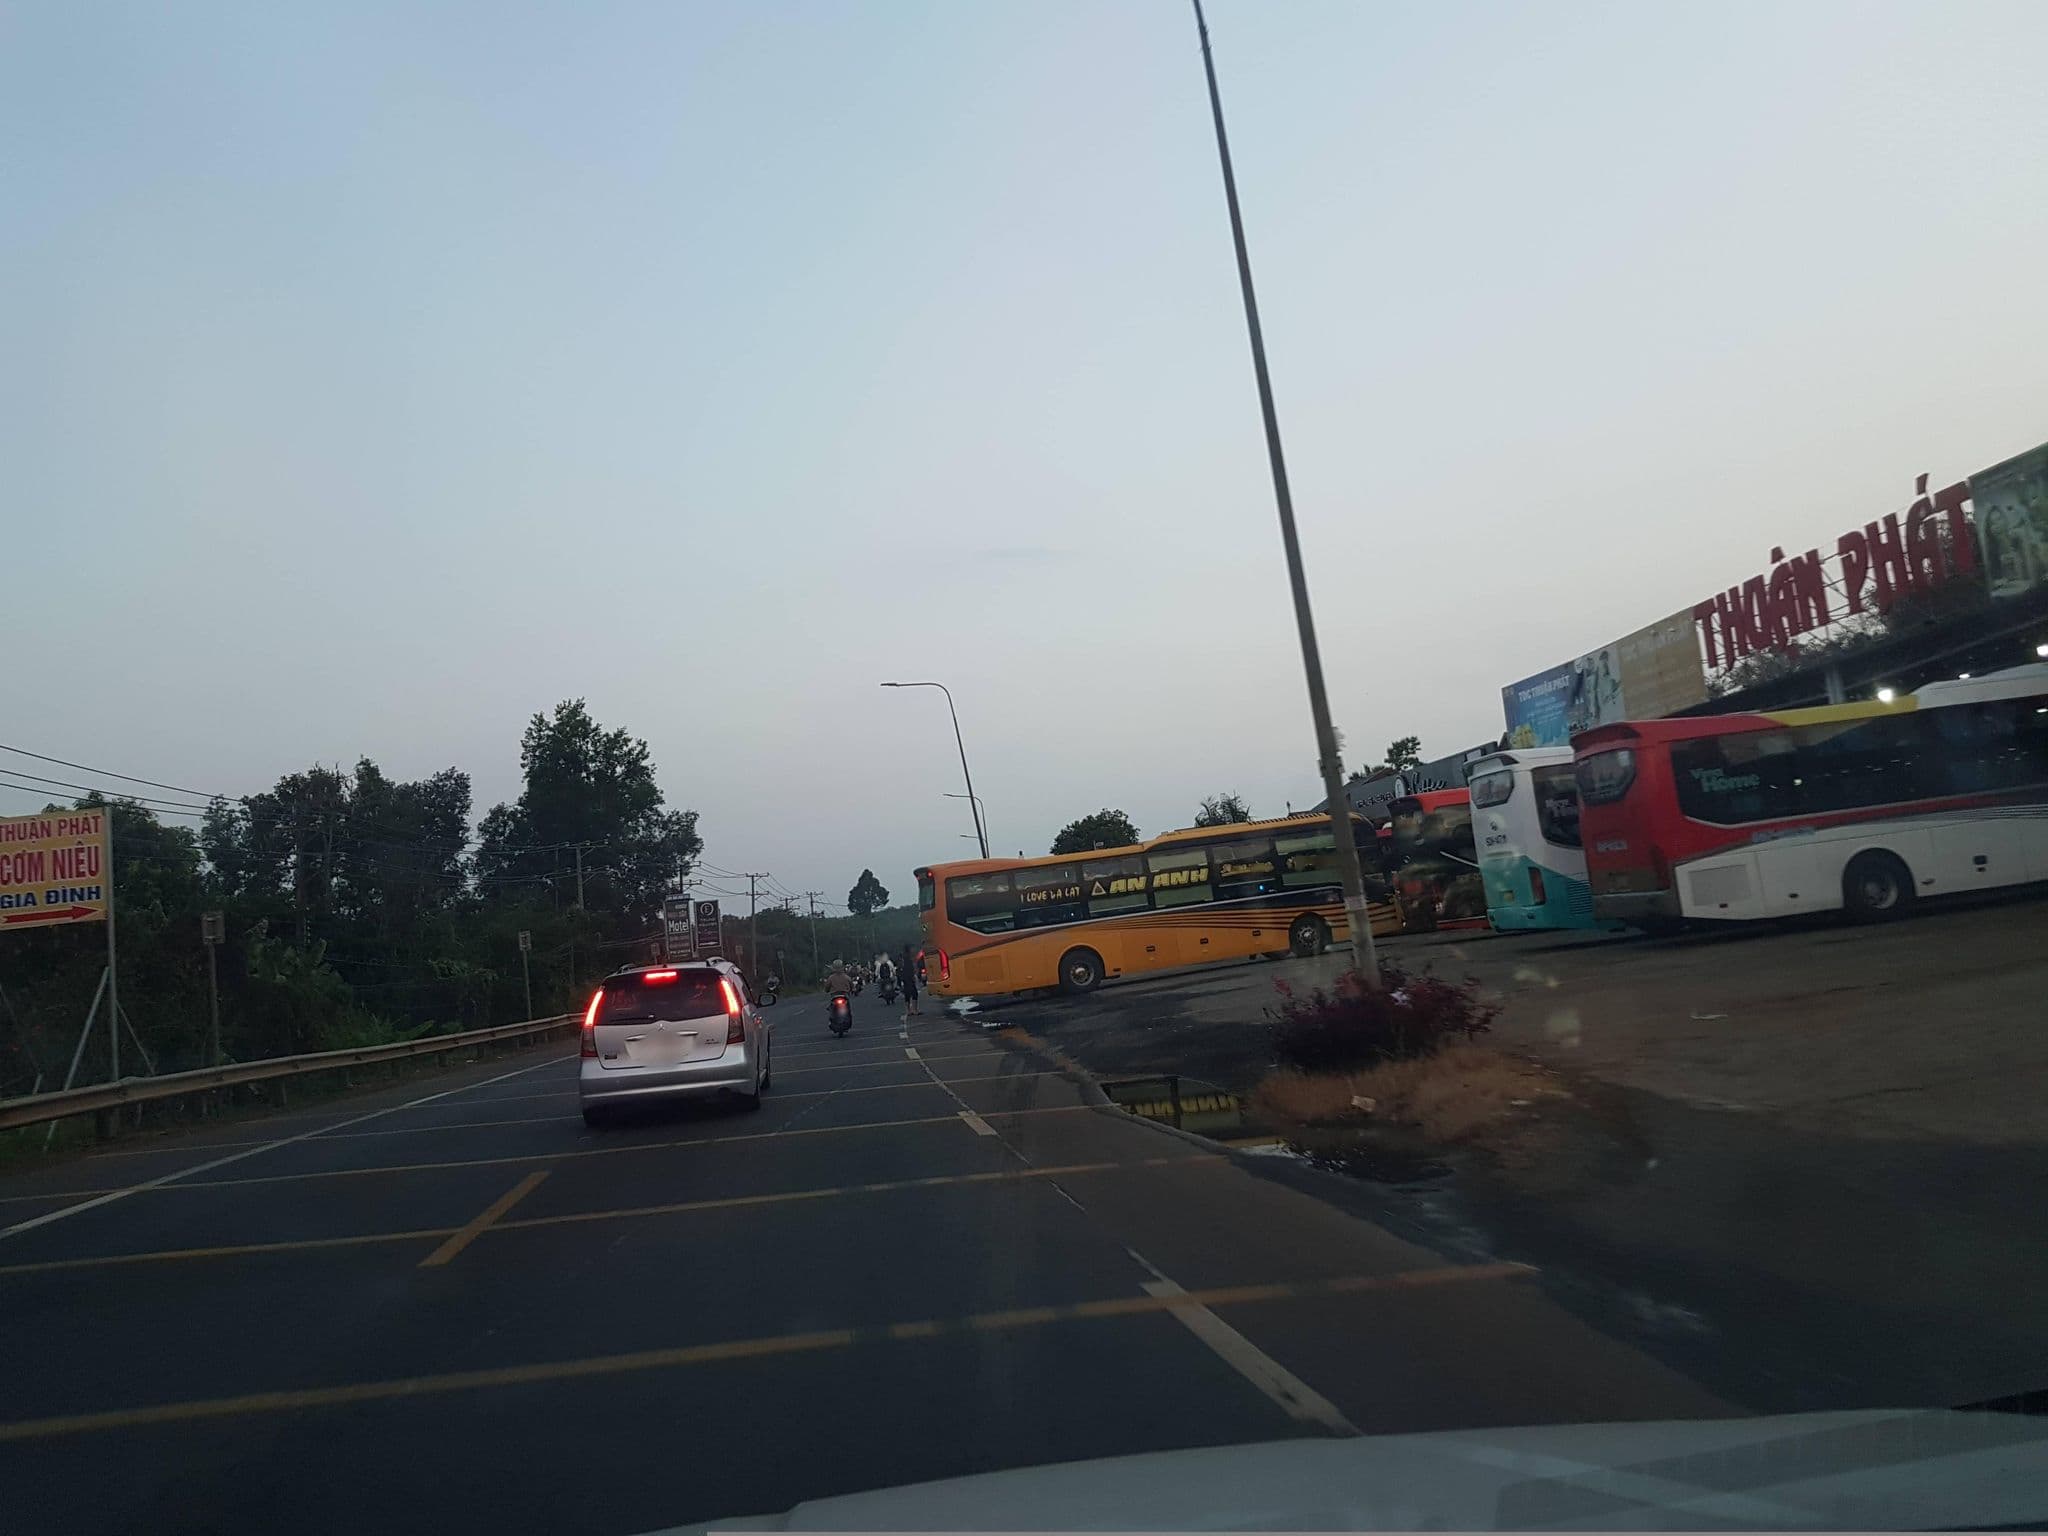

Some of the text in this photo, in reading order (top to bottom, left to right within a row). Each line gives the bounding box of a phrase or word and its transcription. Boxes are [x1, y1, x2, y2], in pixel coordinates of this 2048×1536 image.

[1838, 473, 1975, 616] PHÁT
[0, 813, 102, 843] THUẬN PHÁT
[0, 841, 100, 886] CƠM NIÊU
[1109, 876, 1148, 894] AN
[1152, 868, 1209, 888] ANH
[0, 886, 102, 909] GIA ĐÌNH
[1026, 890, 1047, 902] LOVE
[668, 919, 690, 932] Motel
